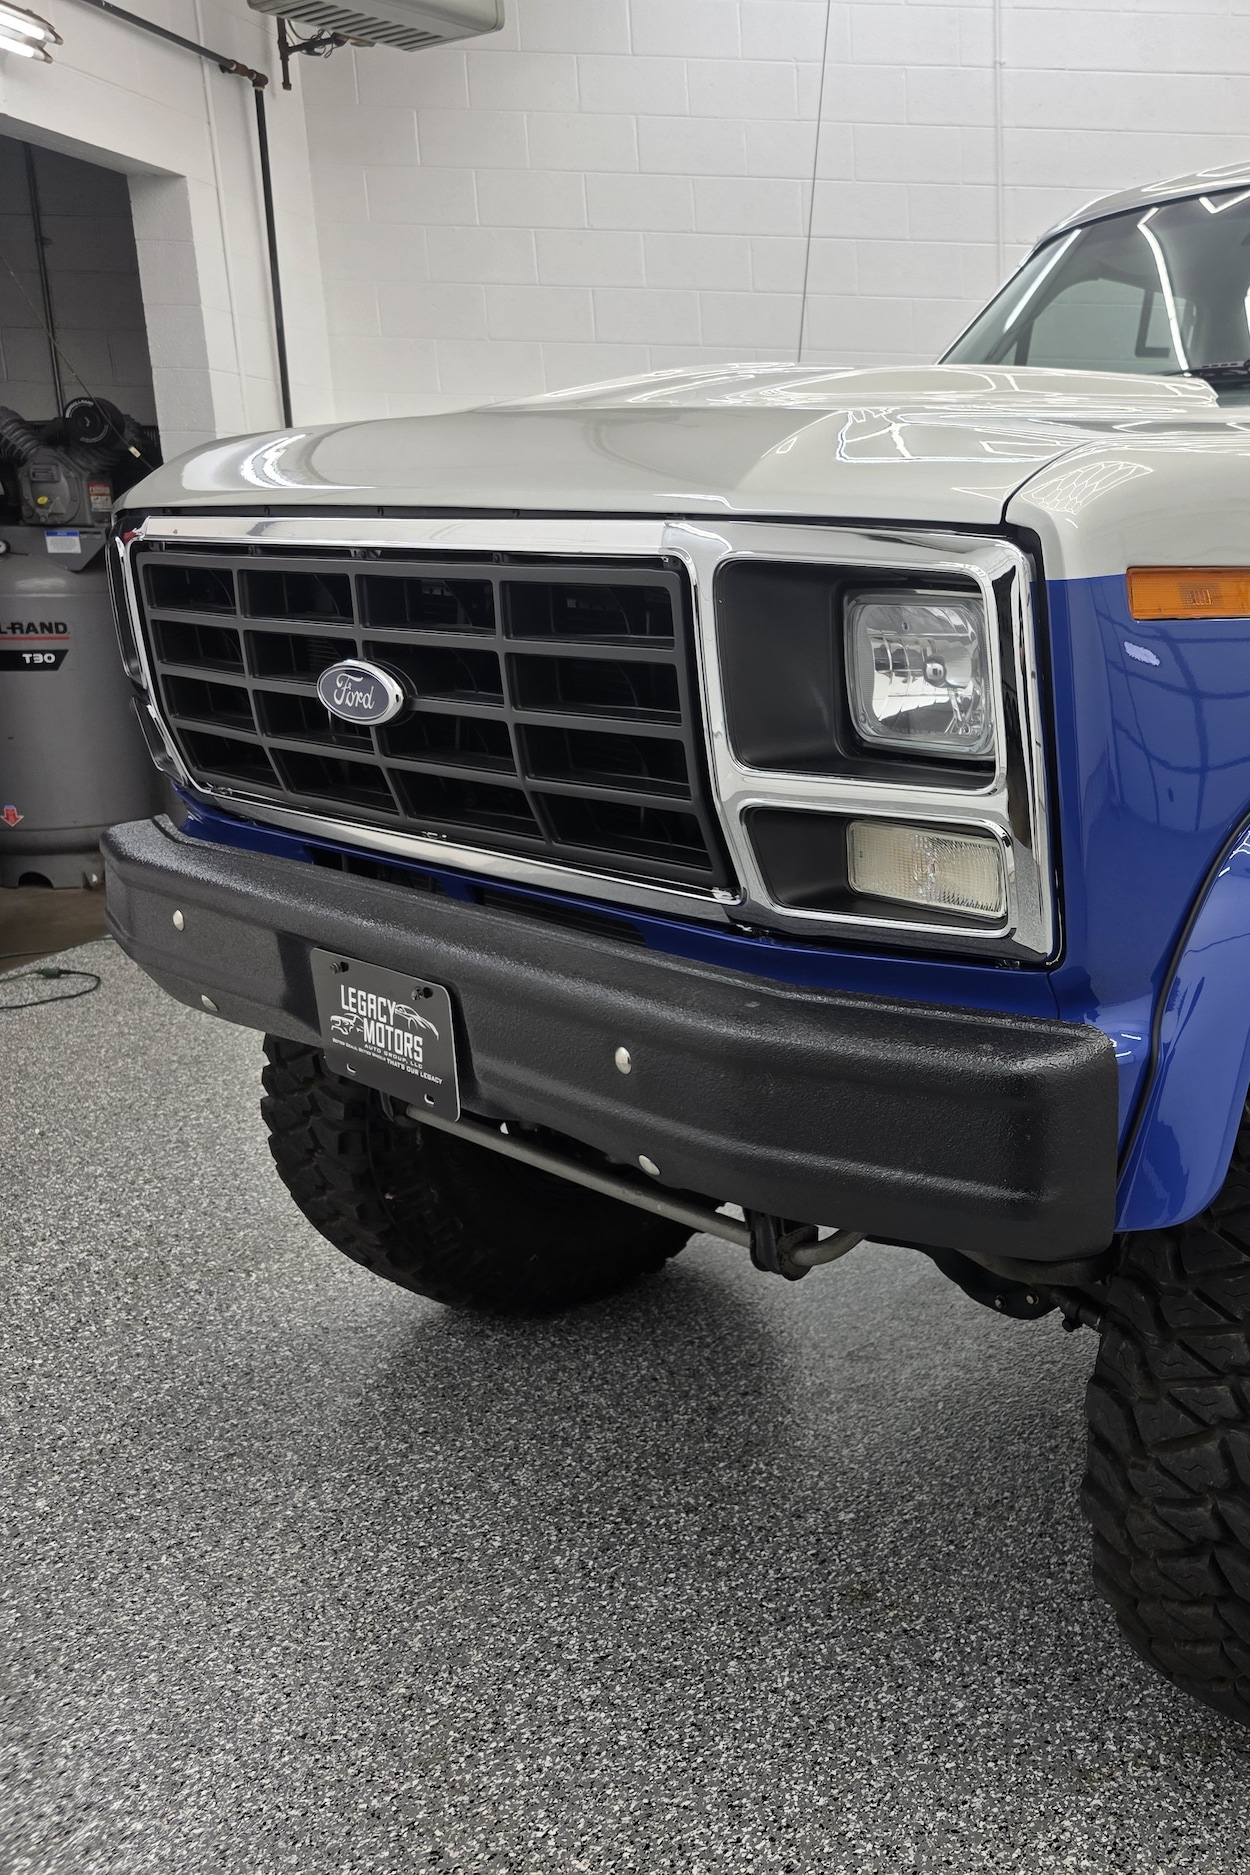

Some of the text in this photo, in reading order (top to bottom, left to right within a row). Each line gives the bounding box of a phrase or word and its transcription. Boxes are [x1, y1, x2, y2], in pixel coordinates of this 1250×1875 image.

[22, 653, 56, 664] T30
[333, 673, 375, 710] Ford
[340, 984, 397, 1026] LEGACY
[363, 1017, 423, 1063] MOTORS
[364, 1044, 382, 1054] AUTO
[410, 1060, 423, 1070] LLC
[386, 1058, 406, 1071] THAT'S
[406, 1066, 419, 1077] OUR
[420, 1071, 443, 1085] LEGACY
